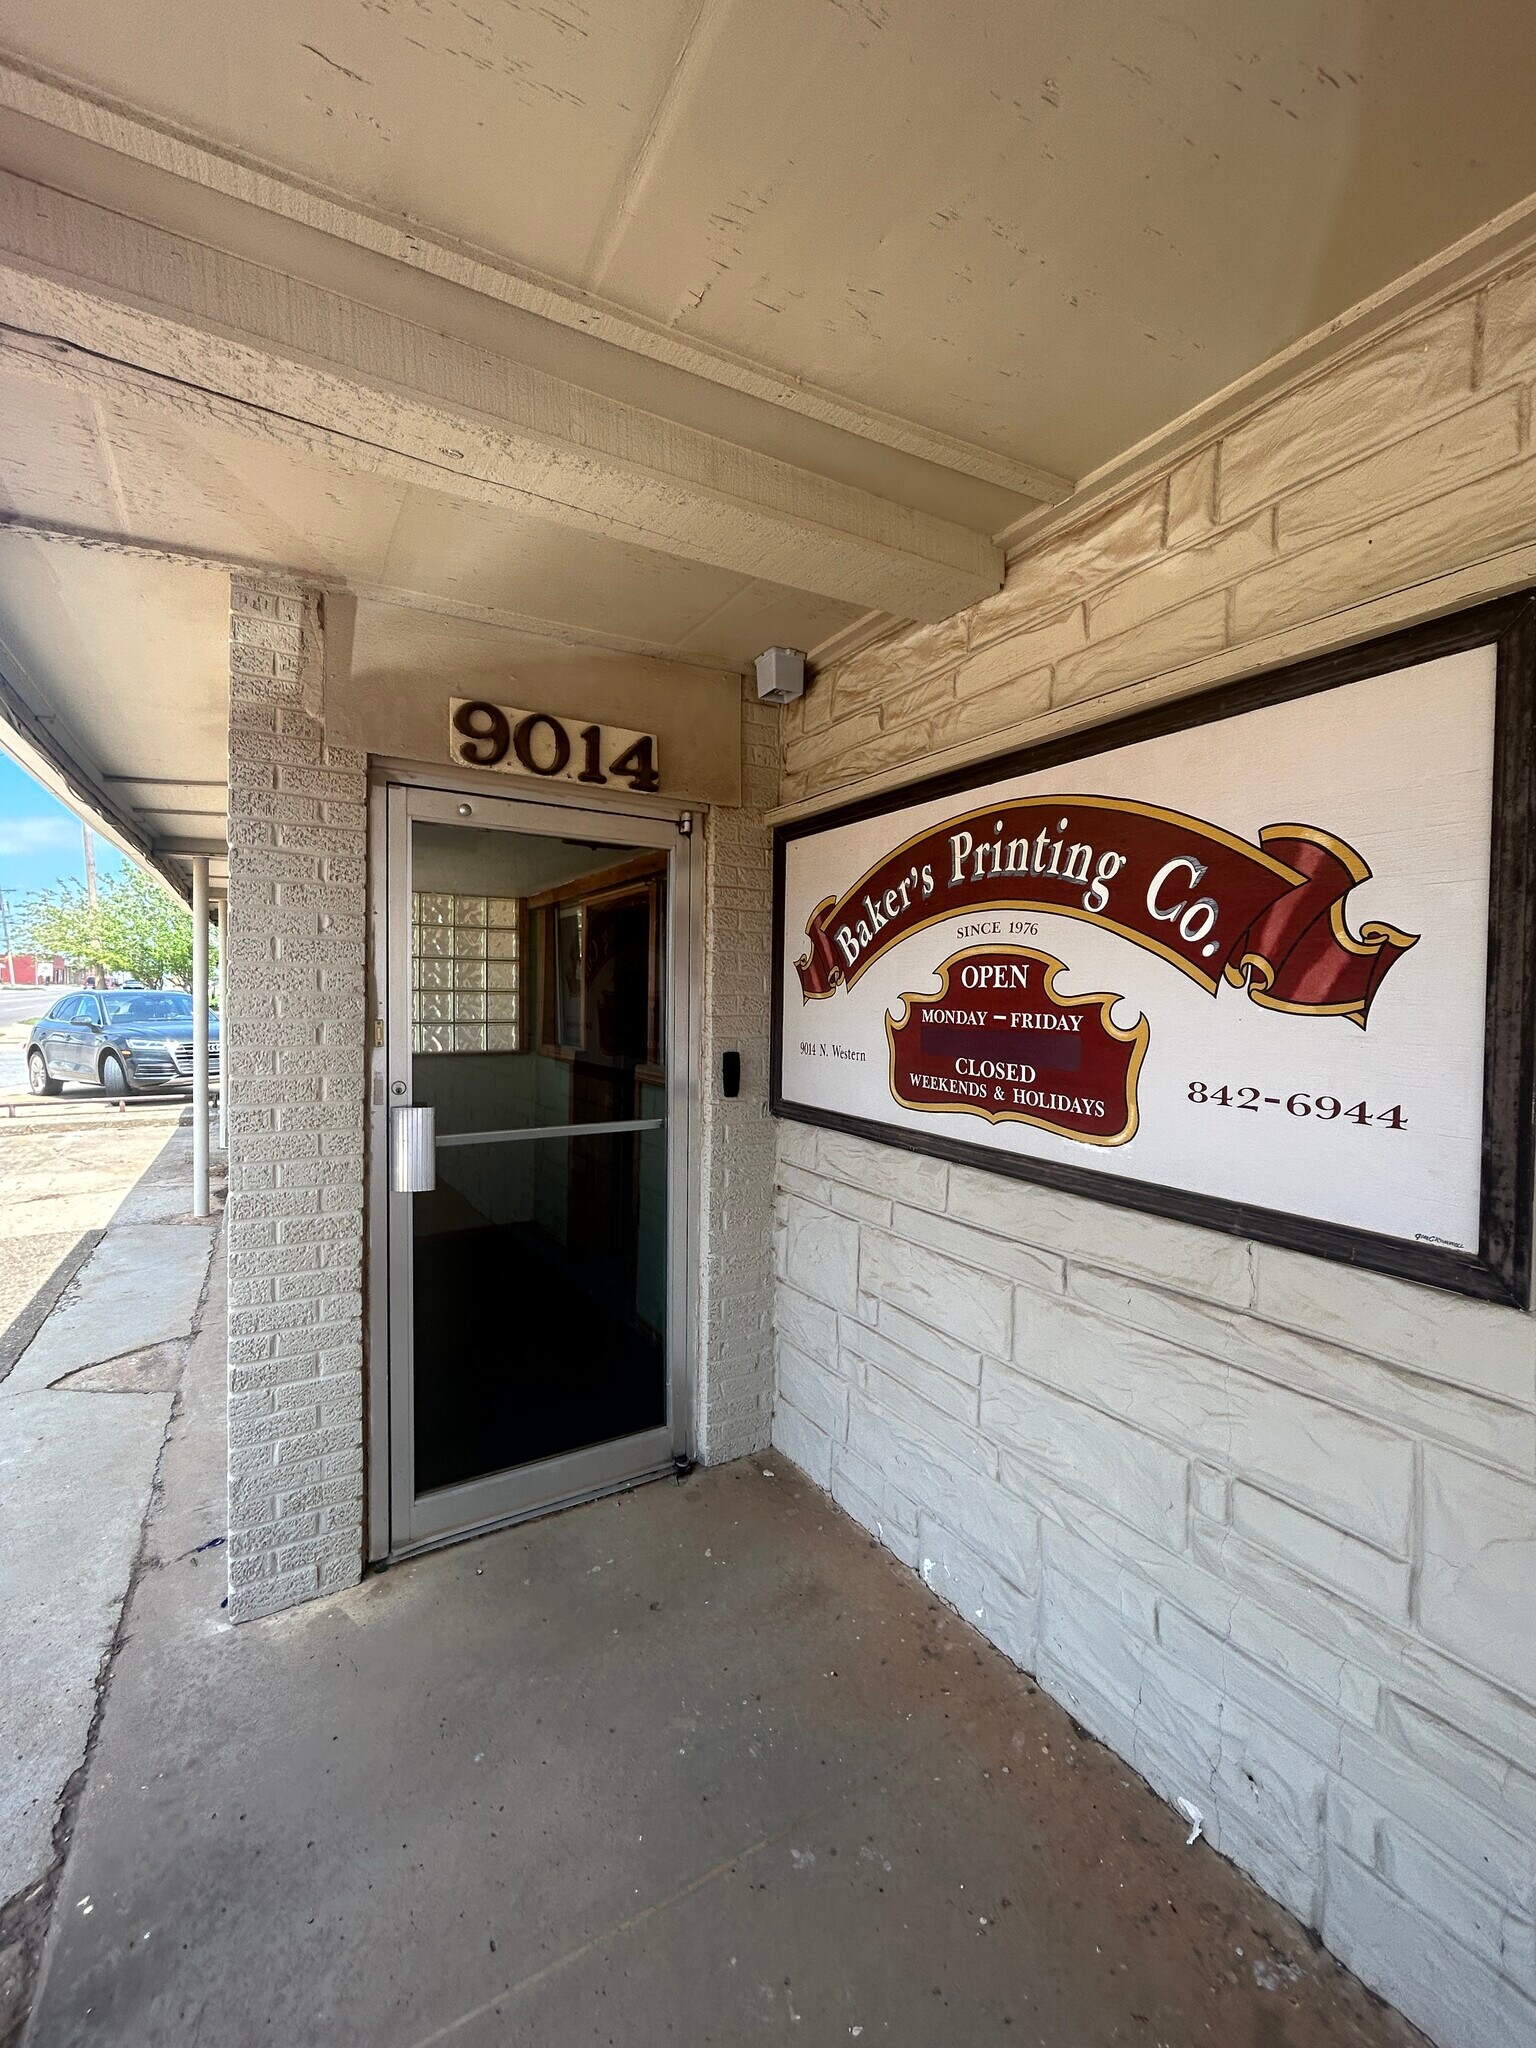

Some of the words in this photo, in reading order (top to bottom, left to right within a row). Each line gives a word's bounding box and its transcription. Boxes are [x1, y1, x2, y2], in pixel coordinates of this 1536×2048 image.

[453, 700, 659, 793] 9014
[834, 861, 935, 968] Baker's
[948, 817, 1127, 913] Printing
[1146, 855, 1219, 958] Co.
[956, 921, 1002, 939] SINCE
[1008, 921, 1039, 936] 1976
[960, 964, 1029, 989] OPEN
[921, 1008, 988, 1026] MONDAY
[1010, 1012, 1084, 1032] FRIDAY
[800, 1041, 816, 1056] 9014
[819, 1043, 829, 1057] N.
[832, 1044, 866, 1062] Western
[955, 1057, 1036, 1084] CLOSED
[909, 1072, 987, 1099] WEEKENDS
[993, 1086, 1006, 1101] &
[1013, 1088, 1105, 1118] HOLIDAYS
[1187, 1081, 1409, 1131] 842-6944
